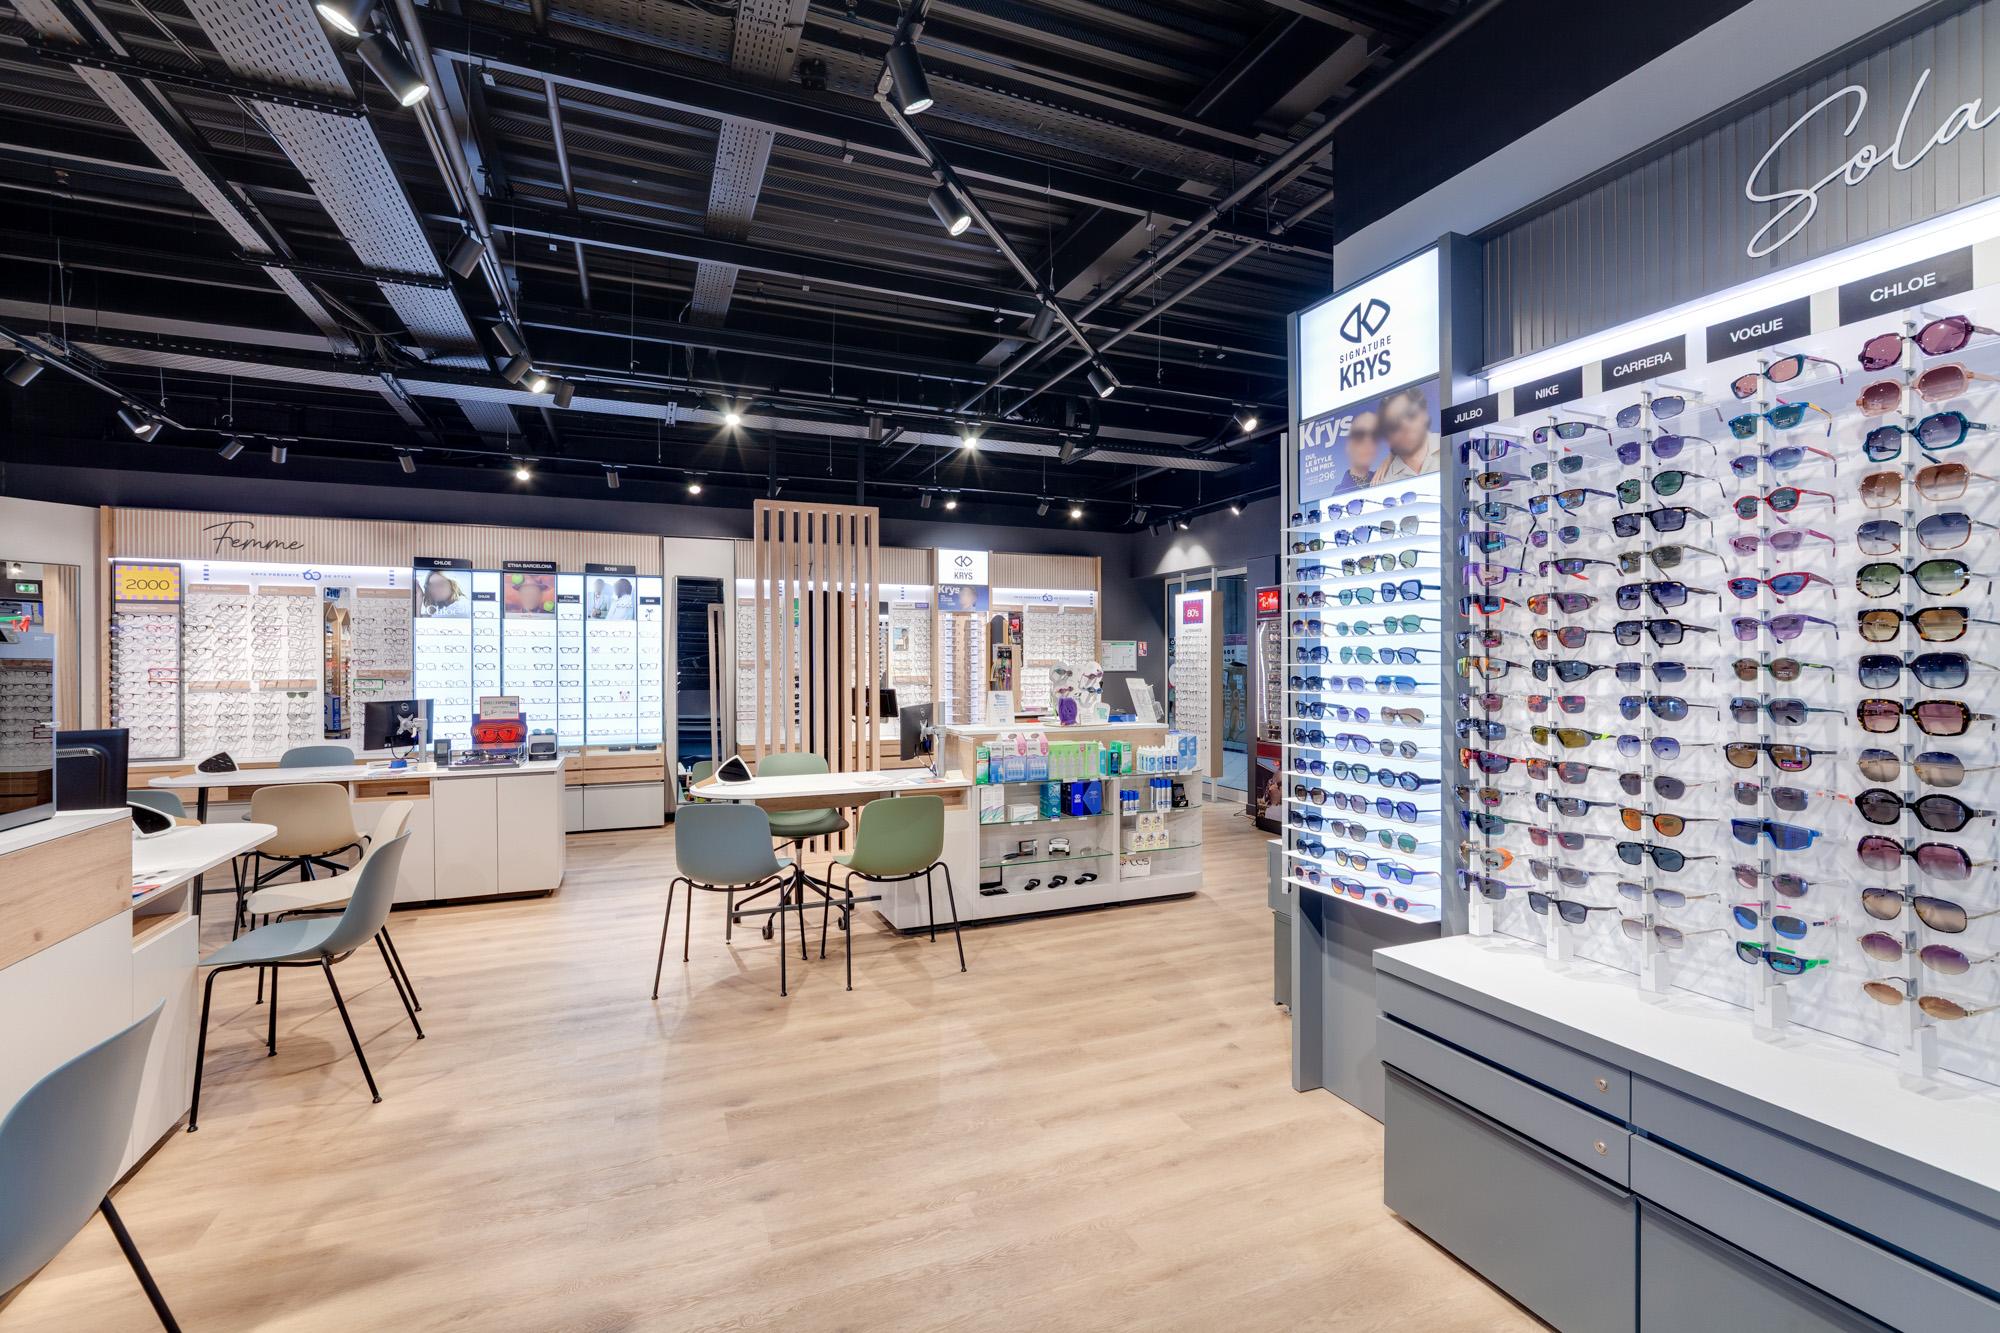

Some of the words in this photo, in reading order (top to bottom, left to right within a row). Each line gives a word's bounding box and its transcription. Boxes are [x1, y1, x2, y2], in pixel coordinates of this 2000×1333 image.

[1870, 272, 1936, 303] CHLOE
[1730, 317, 1784, 343] VOGUE
[1339, 335, 1392, 364] SIGNATURE
[1339, 349, 1392, 391] KRYS
[1613, 352, 1673, 377] CARRERA
[1535, 384, 1559, 400] NIKE
[1454, 407, 1483, 424] JULBO
[1300, 416, 1354, 450] Krys
[1313, 454, 1333, 466] STYLE
[203, 521, 304, 554] Femme
[126, 579, 170, 591] 2000
[954, 571, 973, 580] KRYS
[938, 585, 960, 595] Krys
